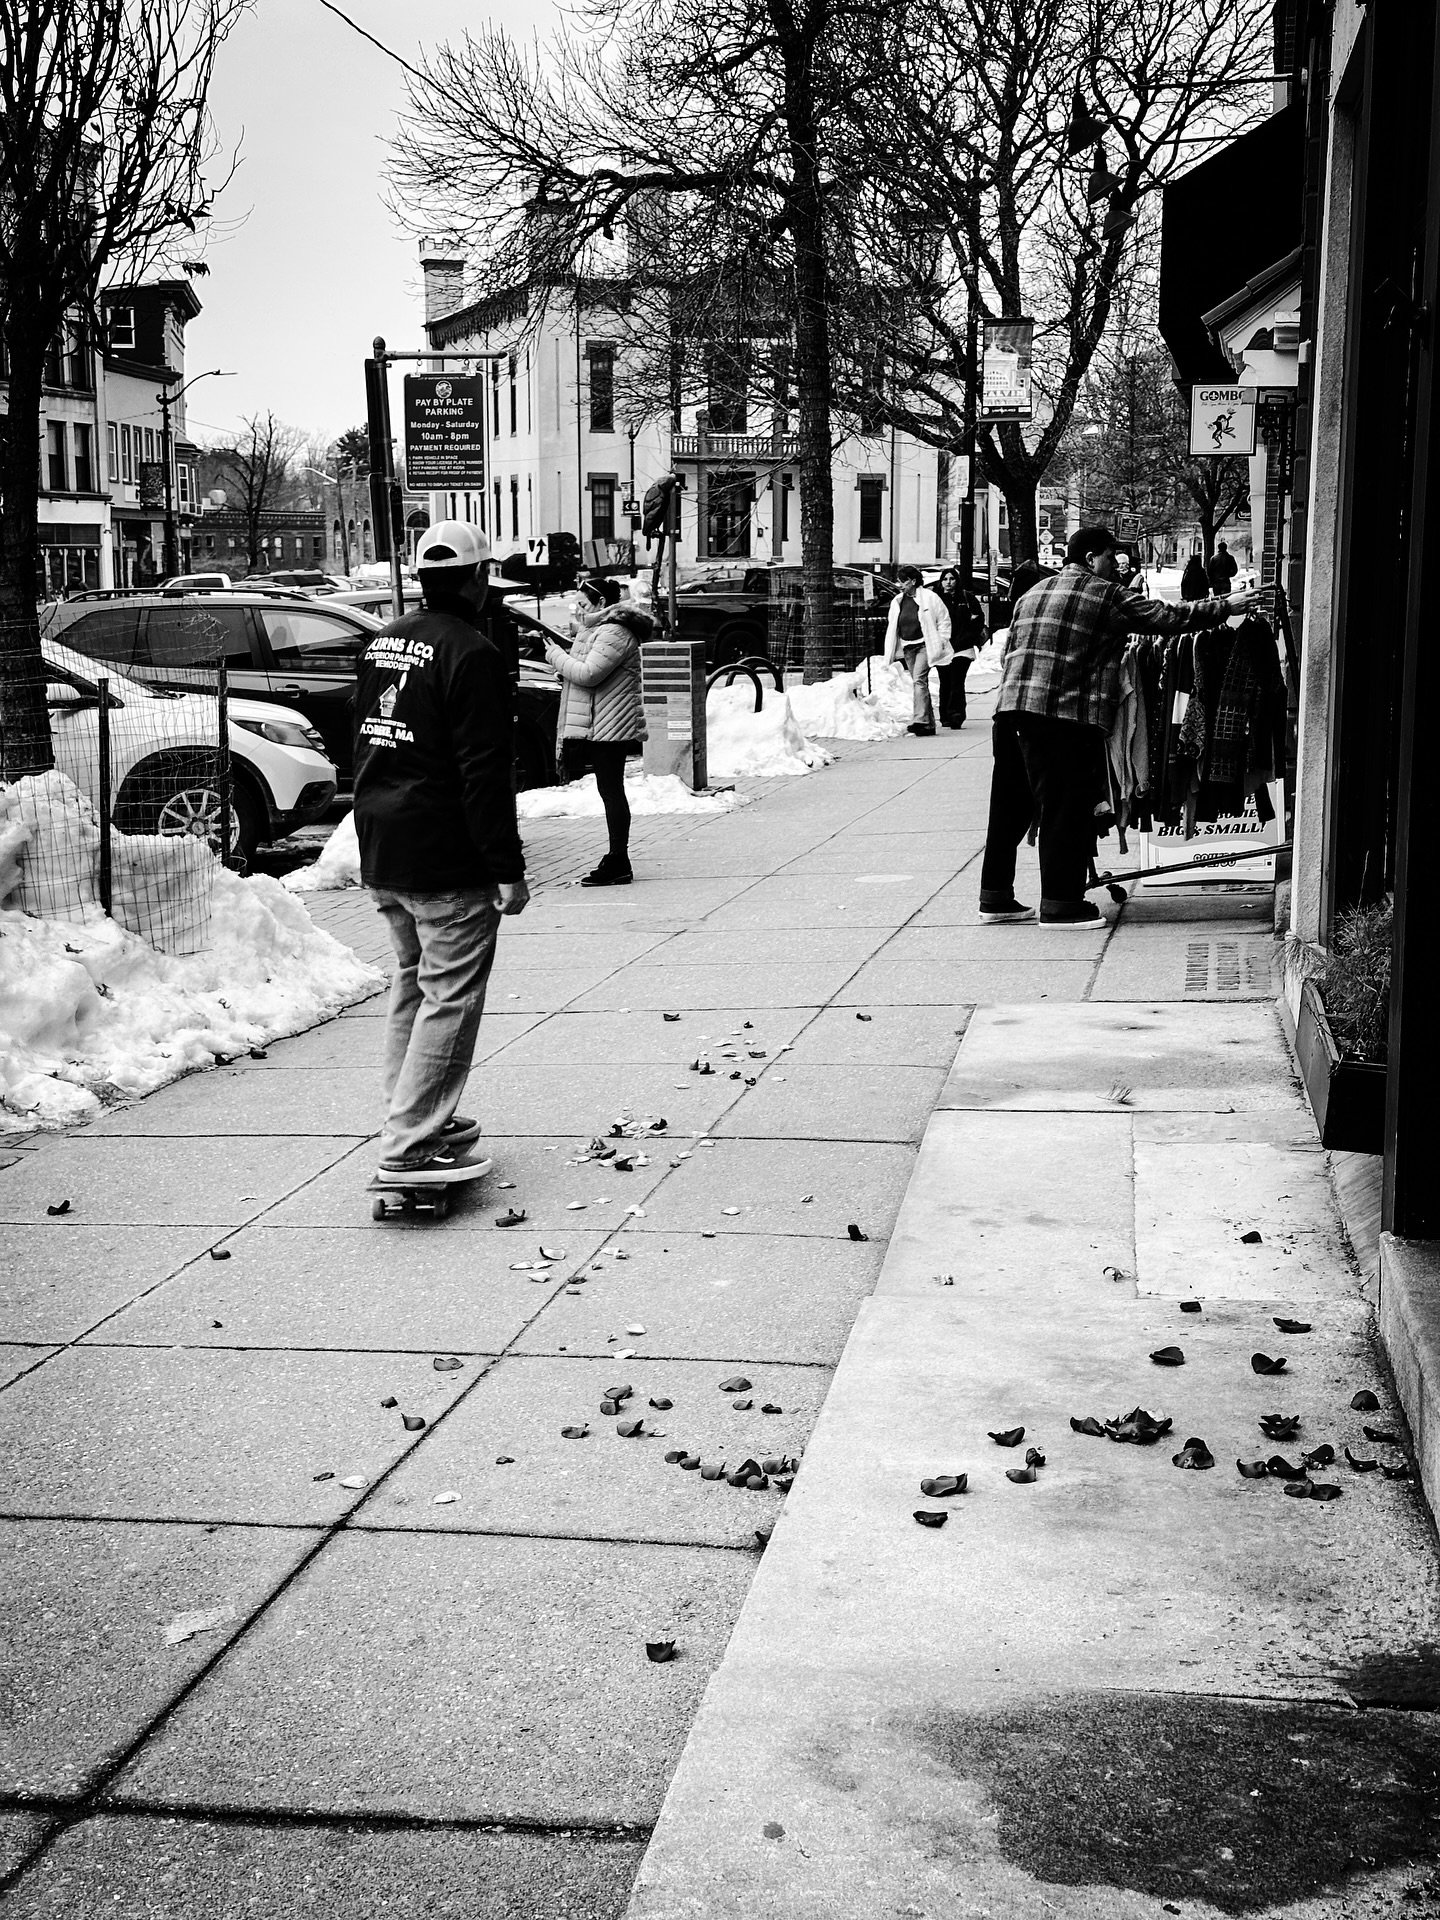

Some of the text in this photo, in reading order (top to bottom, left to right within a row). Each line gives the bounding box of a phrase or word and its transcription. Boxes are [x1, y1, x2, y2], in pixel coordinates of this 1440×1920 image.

[415, 398, 474, 407] PAY BY PLATE
[425, 408, 464, 416] PARKING
[410, 421, 440, 430] Monday
[445, 421, 480, 430] Saturday
[421, 432, 444, 440] 10am
[450, 432, 470, 442] 8pm
[409, 444, 442, 452] PAYMENT
[395, 728, 414, 743] MA
[1158, 826, 1185, 837] BIG
[1204, 822, 1267, 835] SMALL!
